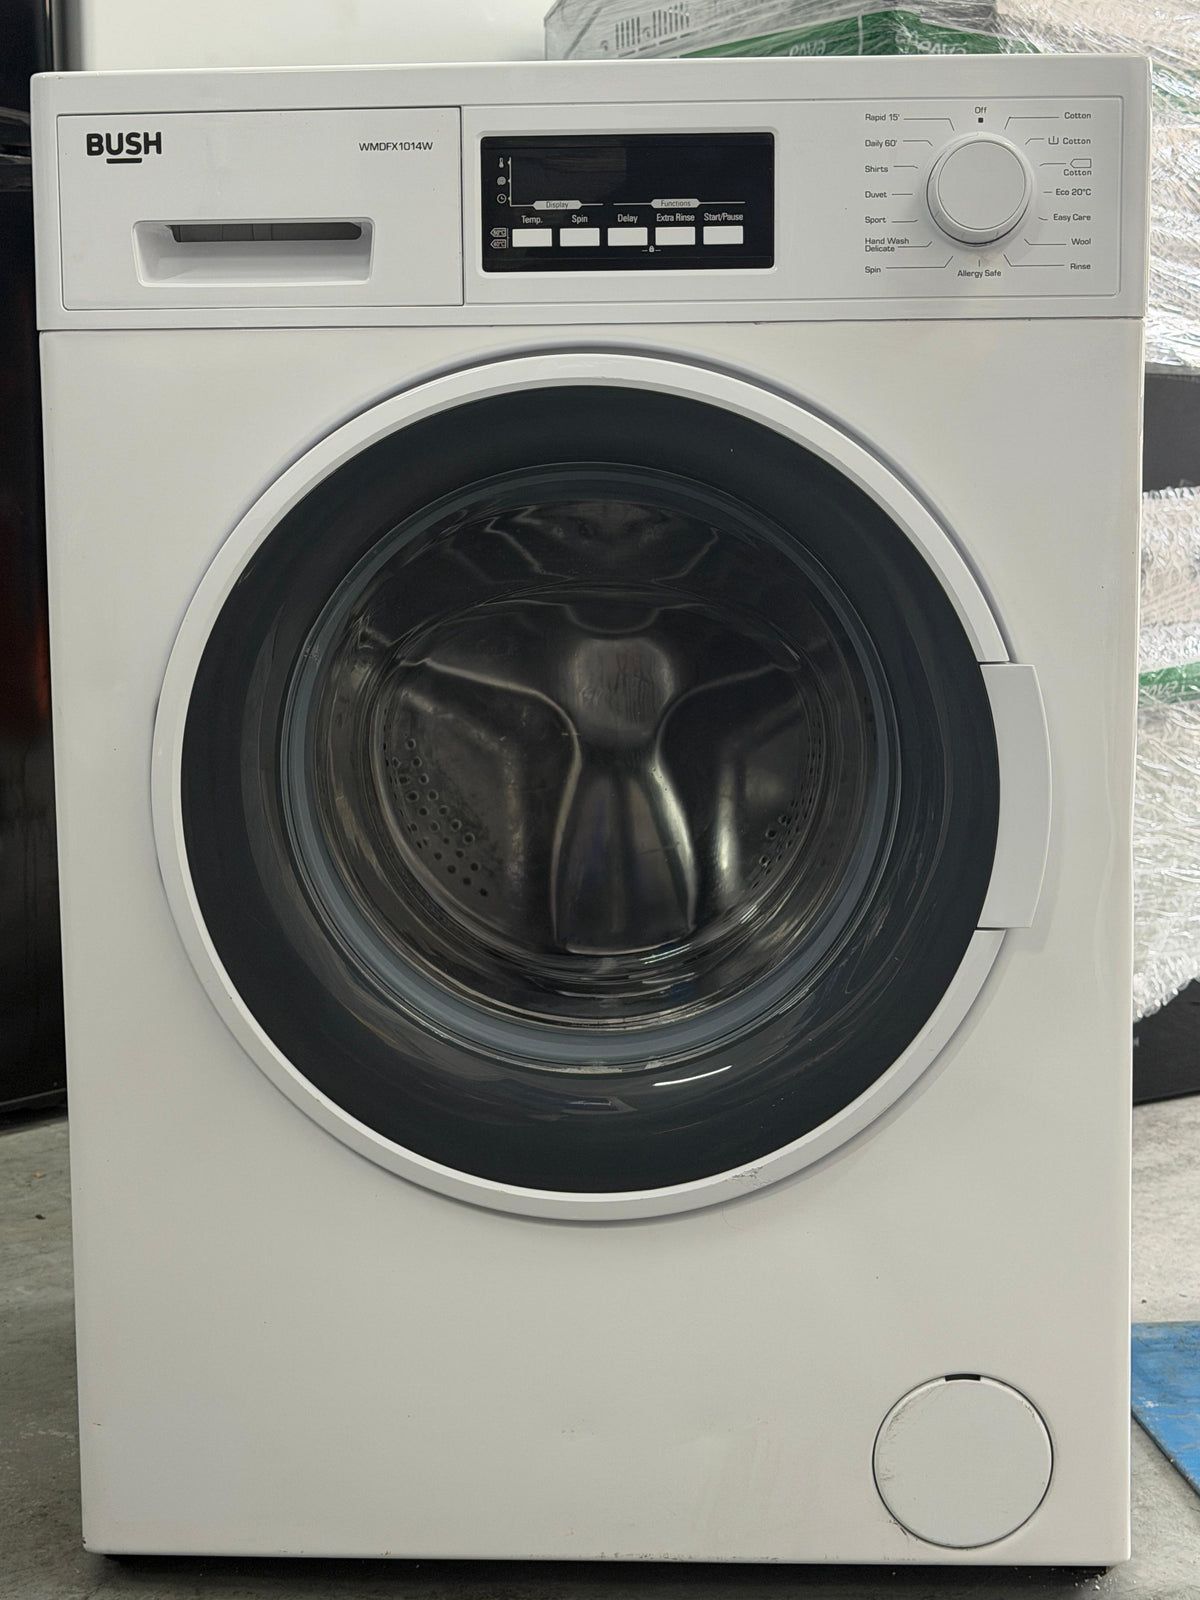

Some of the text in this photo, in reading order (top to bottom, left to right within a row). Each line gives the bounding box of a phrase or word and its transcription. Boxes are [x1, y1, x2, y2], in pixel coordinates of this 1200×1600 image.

[975, 106, 987, 114] Off
[865, 113, 886, 122] Rapid
[86, 131, 162, 157] BUSH
[865, 139, 883, 148] Daily
[1062, 137, 1091, 145] Cotton
[359, 141, 433, 151] WMDFX1014W
[1063, 169, 1092, 177] Cotton
[1055, 188, 1092, 196] Eco 20°C
[545, 200, 569, 210] Display
[660, 199, 692, 208] Functions
[521, 215, 543, 225] Temp.
[571, 214, 588, 224] Spin
[617, 213, 638, 224] Delay
[656, 212, 696, 222] Extra Rinse
[703, 212, 744, 222] Start/Pause
[864, 216, 887, 224] Sport
[1053, 214, 1091, 223] Easy Care
[864, 237, 910, 245] Hand Wash
[1071, 238, 1092, 246] Wool
[864, 244, 896, 252] Delicate
[864, 266, 882, 274] Spin
[957, 269, 1002, 278] Allergy Safe
